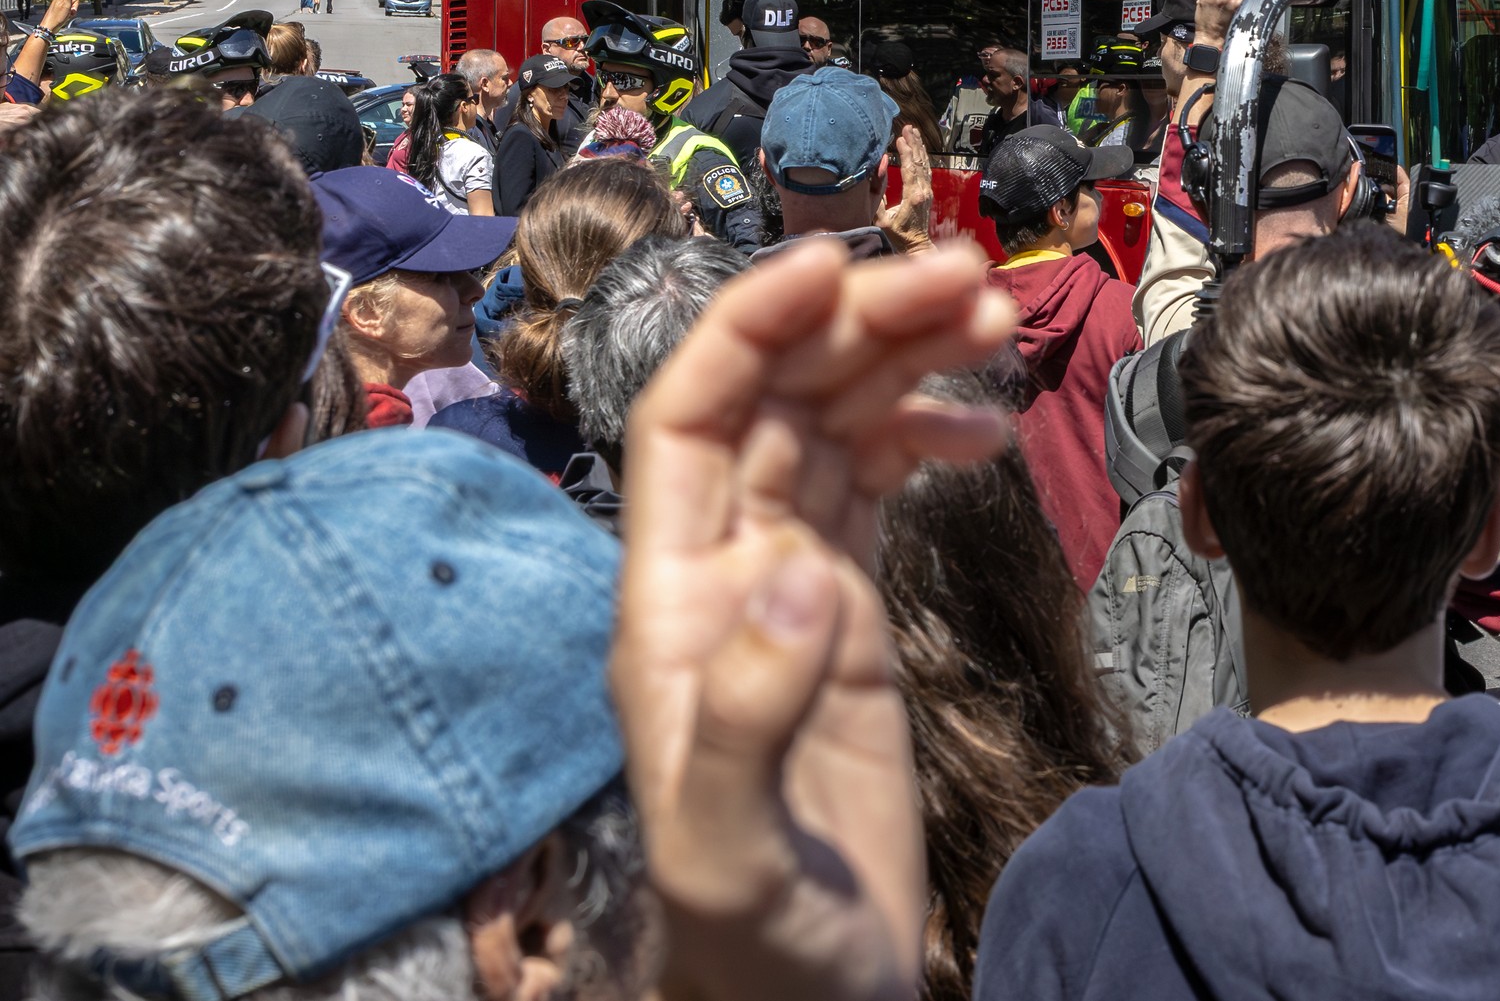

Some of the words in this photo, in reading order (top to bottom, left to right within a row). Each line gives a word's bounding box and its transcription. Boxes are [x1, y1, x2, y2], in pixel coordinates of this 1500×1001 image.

[764, 9, 793, 27] DLF
[169, 50, 215, 73] GIRO
[650, 49, 693, 70] GIRO
[707, 168, 737, 184] POLICE
